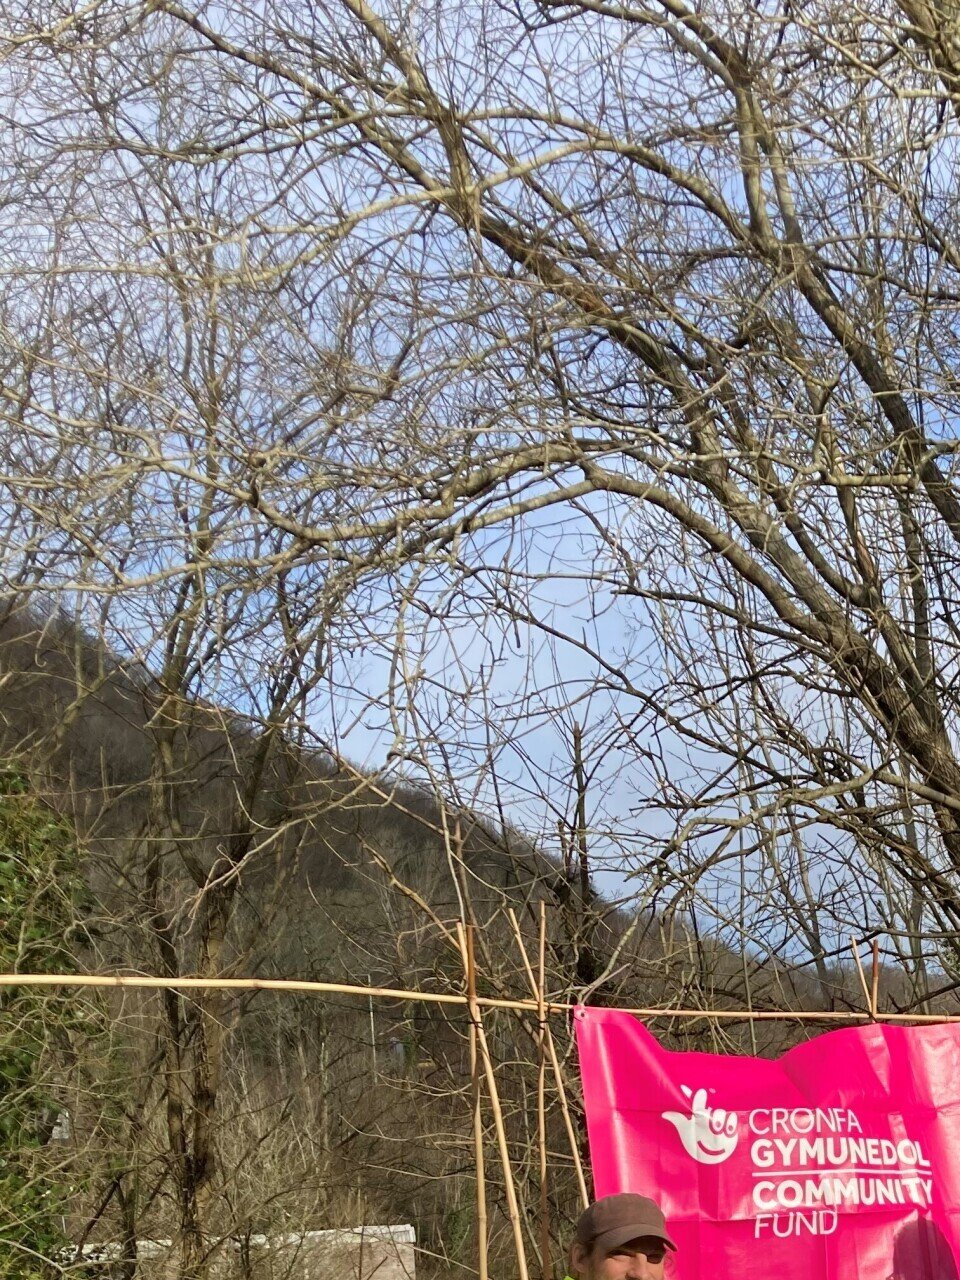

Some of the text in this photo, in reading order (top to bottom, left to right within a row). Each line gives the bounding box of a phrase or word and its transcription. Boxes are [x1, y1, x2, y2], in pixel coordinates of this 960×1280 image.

[749, 1108, 863, 1134] CRONFA
[750, 1137, 931, 1167] GYMUNEDOL
[752, 1177, 933, 1209] COMMUNITY
[754, 1210, 838, 1238] FUND
